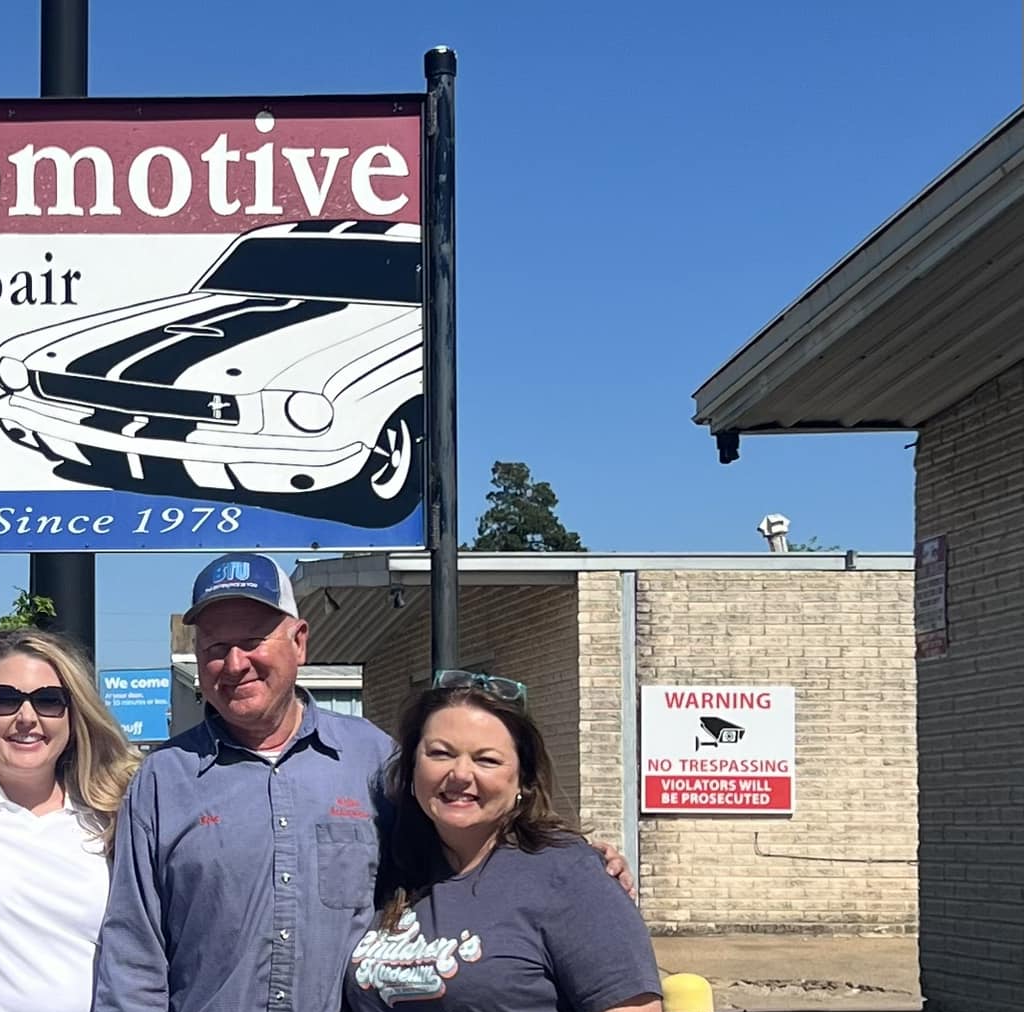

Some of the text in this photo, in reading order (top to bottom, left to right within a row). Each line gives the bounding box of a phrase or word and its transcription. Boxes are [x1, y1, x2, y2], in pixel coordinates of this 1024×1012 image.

[131, 507, 243, 535] 1978
[104, 676, 170, 689] We come
[665, 692, 772, 709] WARNING
[647, 759, 789, 773] NO TRESPASSING
[661, 778, 772, 792] VIOLATORS WILL
[661, 793, 770, 805] BE PROSECUTED
